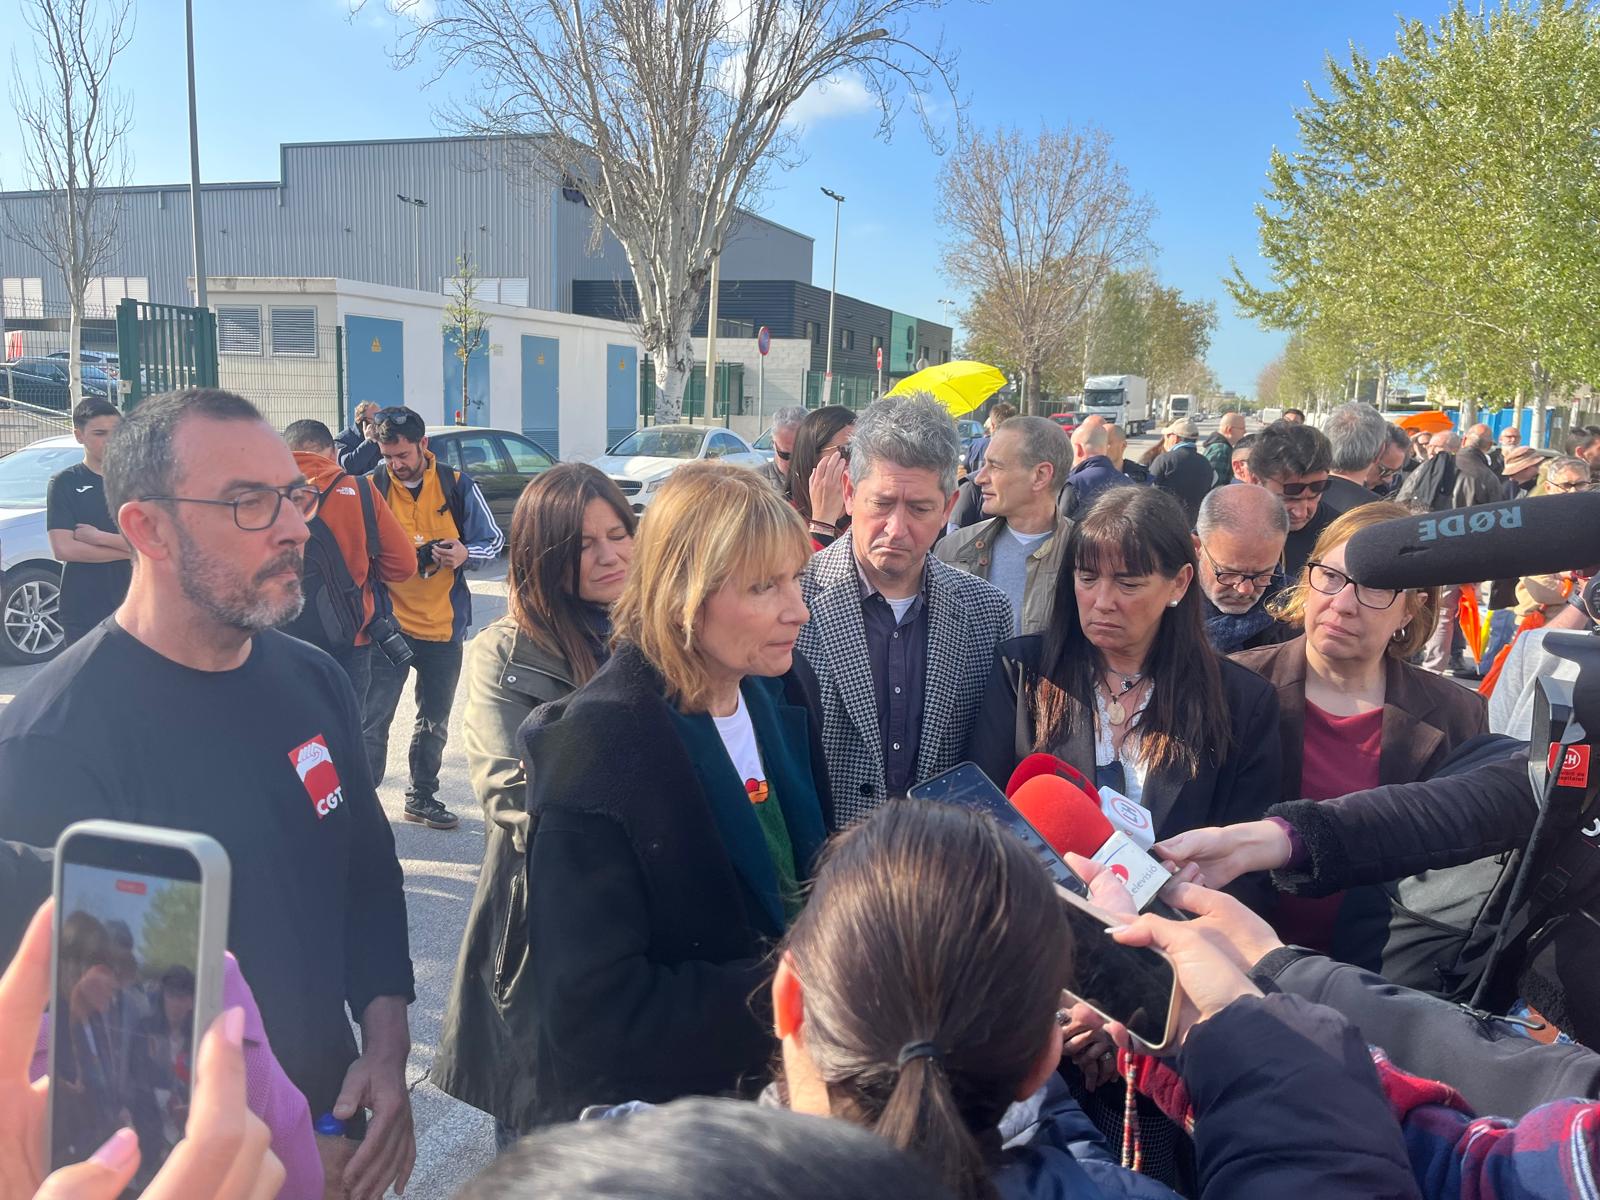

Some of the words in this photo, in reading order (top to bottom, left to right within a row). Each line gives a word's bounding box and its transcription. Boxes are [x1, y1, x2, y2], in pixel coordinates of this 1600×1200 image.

[1418, 506, 1522, 541] RØDE
[317, 785, 343, 815] CGT
[1131, 864, 1158, 895] elevisió
